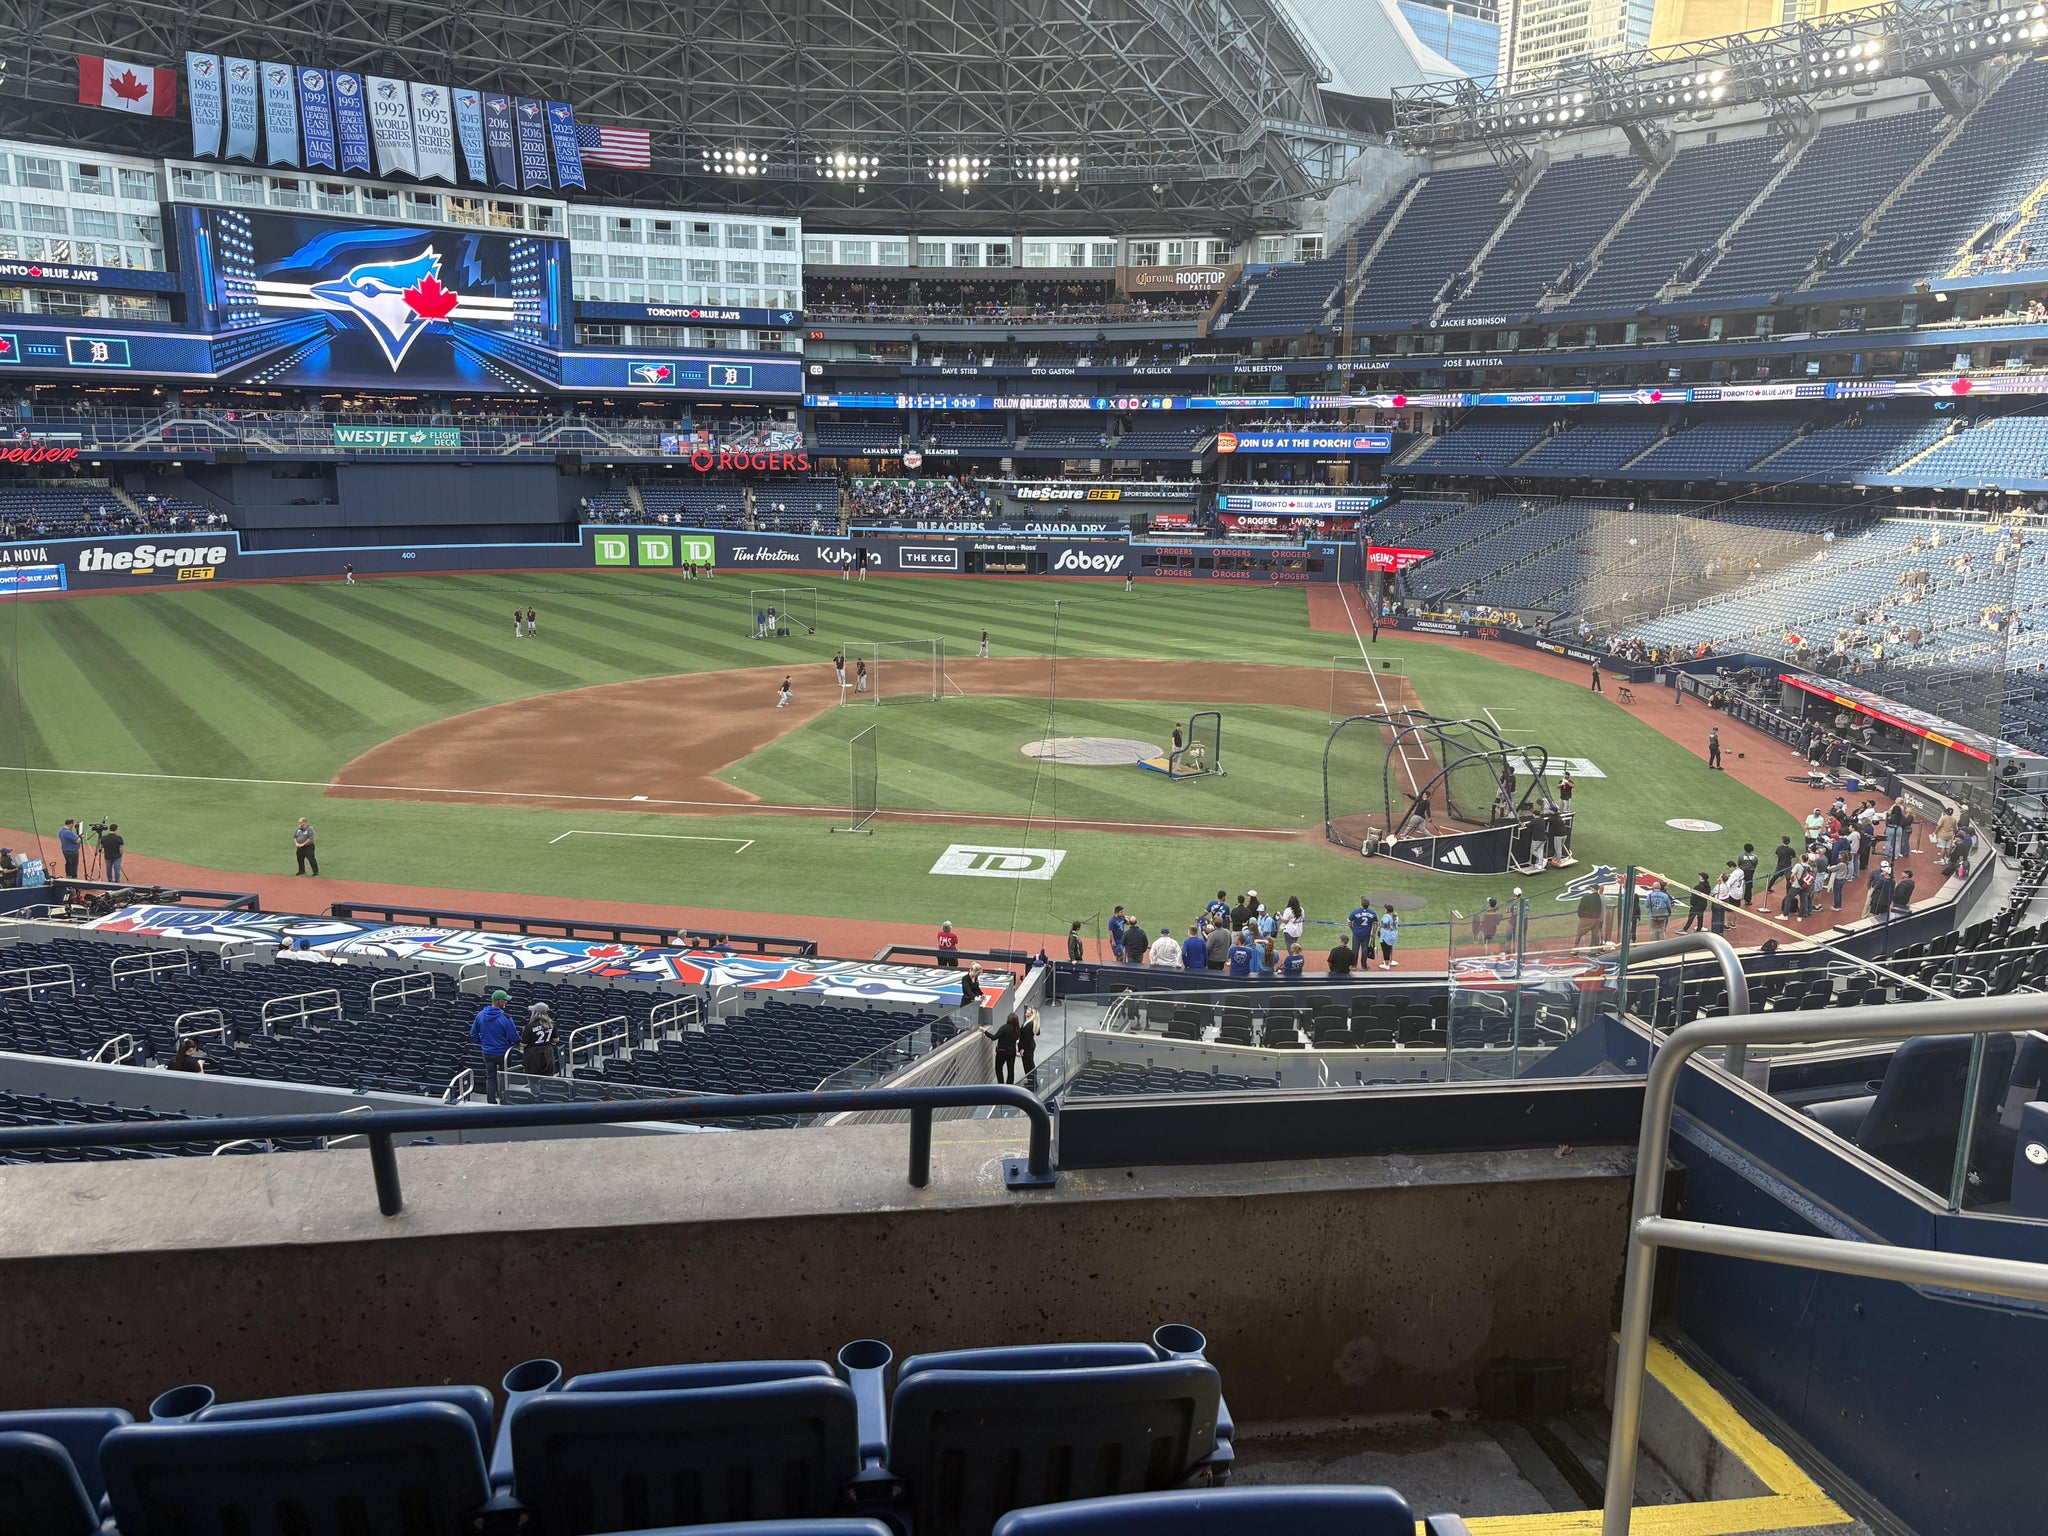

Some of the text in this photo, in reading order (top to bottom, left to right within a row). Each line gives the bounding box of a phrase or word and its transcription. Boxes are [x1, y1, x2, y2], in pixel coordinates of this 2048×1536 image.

[194, 79, 217, 91] 1985
[231, 84, 253, 96] 1989
[269, 88, 290, 100] 1991
[304, 92, 327, 104] 1992
[194, 100, 219, 109] LEAGUE
[231, 98, 254, 106] AMERICAN
[195, 108, 219, 118] EAST
[231, 104, 254, 113] LEAGUE
[268, 108, 293, 117] LEAGUE
[305, 105, 328, 113] AMERICAN
[374, 101, 406, 117] 1992
[232, 112, 254, 123] EAST
[305, 111, 328, 120] LEAGUE
[339, 116, 363, 124] LEAGUE
[417, 108, 448, 125] 1993
[460, 112, 479, 123] 2015
[195, 117, 220, 126] CHAMPS
[232, 122, 255, 131] CHAMPS
[269, 116, 294, 127] EAST
[307, 119, 329, 130] EAST
[374, 119, 409, 130] WORLD
[488, 117, 509, 129] 2016
[270, 126, 295, 135] CHAMPS
[307, 128, 331, 137] CHAMPS
[340, 124, 364, 133] EAST
[418, 125, 450, 137] WORLD
[522, 127, 542, 138] 2016
[553, 124, 573, 134] 2025
[376, 130, 410, 140] SERIES
[489, 130, 511, 141] ALDS
[309, 141, 332, 152] ALCS
[377, 140, 411, 148] CHAMPIONS
[418, 135, 451, 148] SERIES
[489, 140, 511, 148] CHAMPS
[555, 140, 576, 148] LEAGUE
[344, 145, 367, 156] ALCS
[420, 146, 452, 156] CHAMPIONS
[522, 142, 544, 152] 2020
[557, 147, 577, 156] EAST
[309, 151, 332, 160] CHAMPS
[558, 154, 578, 163] CHAMPS
[524, 156, 546, 166] 2022
[526, 169, 548, 180] 2023
[561, 165, 581, 174] ALCS
[561, 173, 583, 181] CHAMPS
[42, 267, 99, 281] BLUE JAYS
[1136, 272, 1225, 286] Corona ROOFTOP
[646, 308, 740, 320] TORONTO BLUE JAYS
[1440, 318, 1466, 328] JACKIE
[1466, 317, 1507, 326] ROBINSON
[1353, 362, 1390, 370] HALLADAY
[1442, 357, 1503, 368] JOSÉ BAUTISTA
[1147, 367, 1172, 375] GILLICK
[1234, 364, 1283, 373] PAUL BEESTON
[993, 398, 1091, 409] FOLLOW @BLUEJAYS ON SOCIAL
[337, 430, 460, 447] WESTJET FLIGHT
[434, 439, 456, 447] DECK
[1239, 439, 1259, 447] JOIN
[1262, 439, 1274, 447] US
[1276, 439, 1290, 447] AT
[1292, 439, 1310, 447] THE
[1313, 438, 1351, 448] PORCH!
[719, 453, 809, 471] ROGERS
[1017, 487, 1084, 500] theScore
[1088, 490, 1120, 499] BET
[1253, 500, 1288, 508] TORONTO
[1314, 501, 1332, 509] JAYS
[1247, 517, 1278, 525] ROGERS
[916, 521, 1107, 532] BLEACHERS CANADA DRY
[14, 548, 48, 562] NOVA
[598, 540, 626, 560] TD
[641, 541, 669, 560] TD
[684, 541, 712, 560] TD
[732, 547, 800, 562] Tim Hortons
[78, 545, 227, 571] theScore
[906, 554, 951, 562] THE KEG
[1054, 549, 1125, 573] Sobeys
[1369, 552, 1395, 565] HEINZ
[181, 568, 213, 579] BET
[1163, 569, 1192, 577] ROGERS
[1378, 617, 1399, 627] HEINZ
[1417, 620, 1457, 630] CANADIAN KETCHUP
[1477, 628, 1500, 638] HEINZ
[1567, 650, 1590, 660] BASELINE
[958, 850, 1047, 871] TD
[2032, 1149, 2040, 1158] 2
